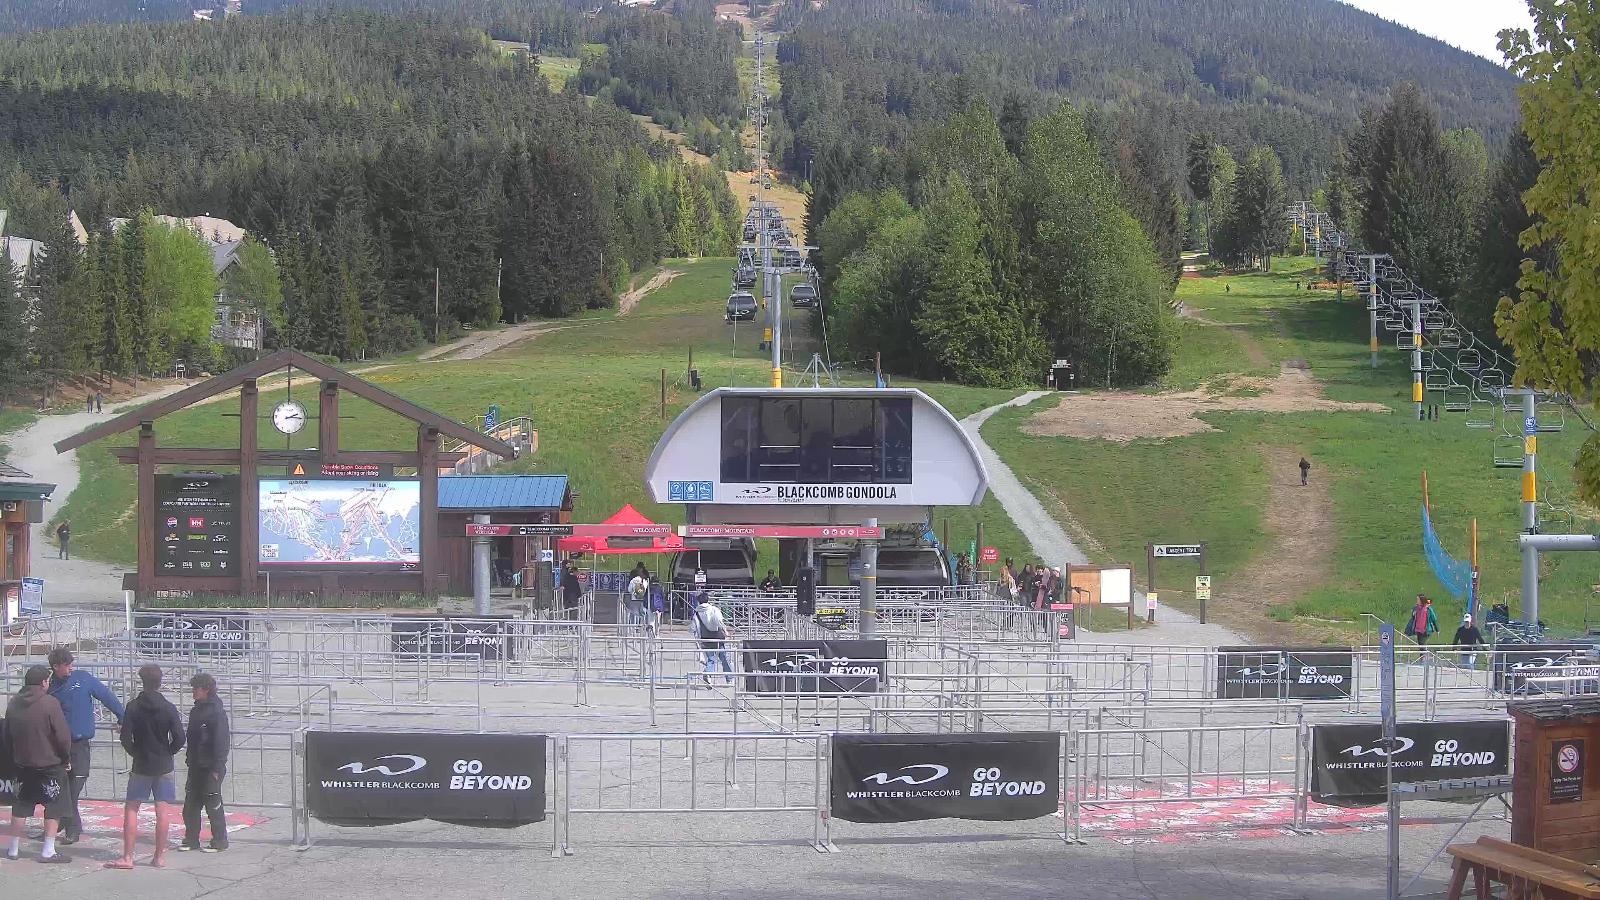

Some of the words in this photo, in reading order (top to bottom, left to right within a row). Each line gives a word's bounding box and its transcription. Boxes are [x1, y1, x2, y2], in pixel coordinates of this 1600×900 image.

[777, 486, 844, 498] BLACKCOMB
[846, 486, 897, 499] GONDOLA
[829, 666, 879, 675] BEYOND
[1300, 666, 1317, 674] GO
[1298, 675, 1343, 684] BEYOND
[1434, 739, 1458, 753] GO
[1430, 752, 1496, 767] BEYOND
[452, 759, 483, 774] GO
[973, 767, 1001, 782] GO
[321, 780, 380, 789] WHISTLER
[381, 780, 440, 789] BLACKCOMB
[450, 775, 532, 790] BEYOND
[970, 781, 1045, 797] BEYOND
[905, 789, 961, 798] BLACKCOMB
